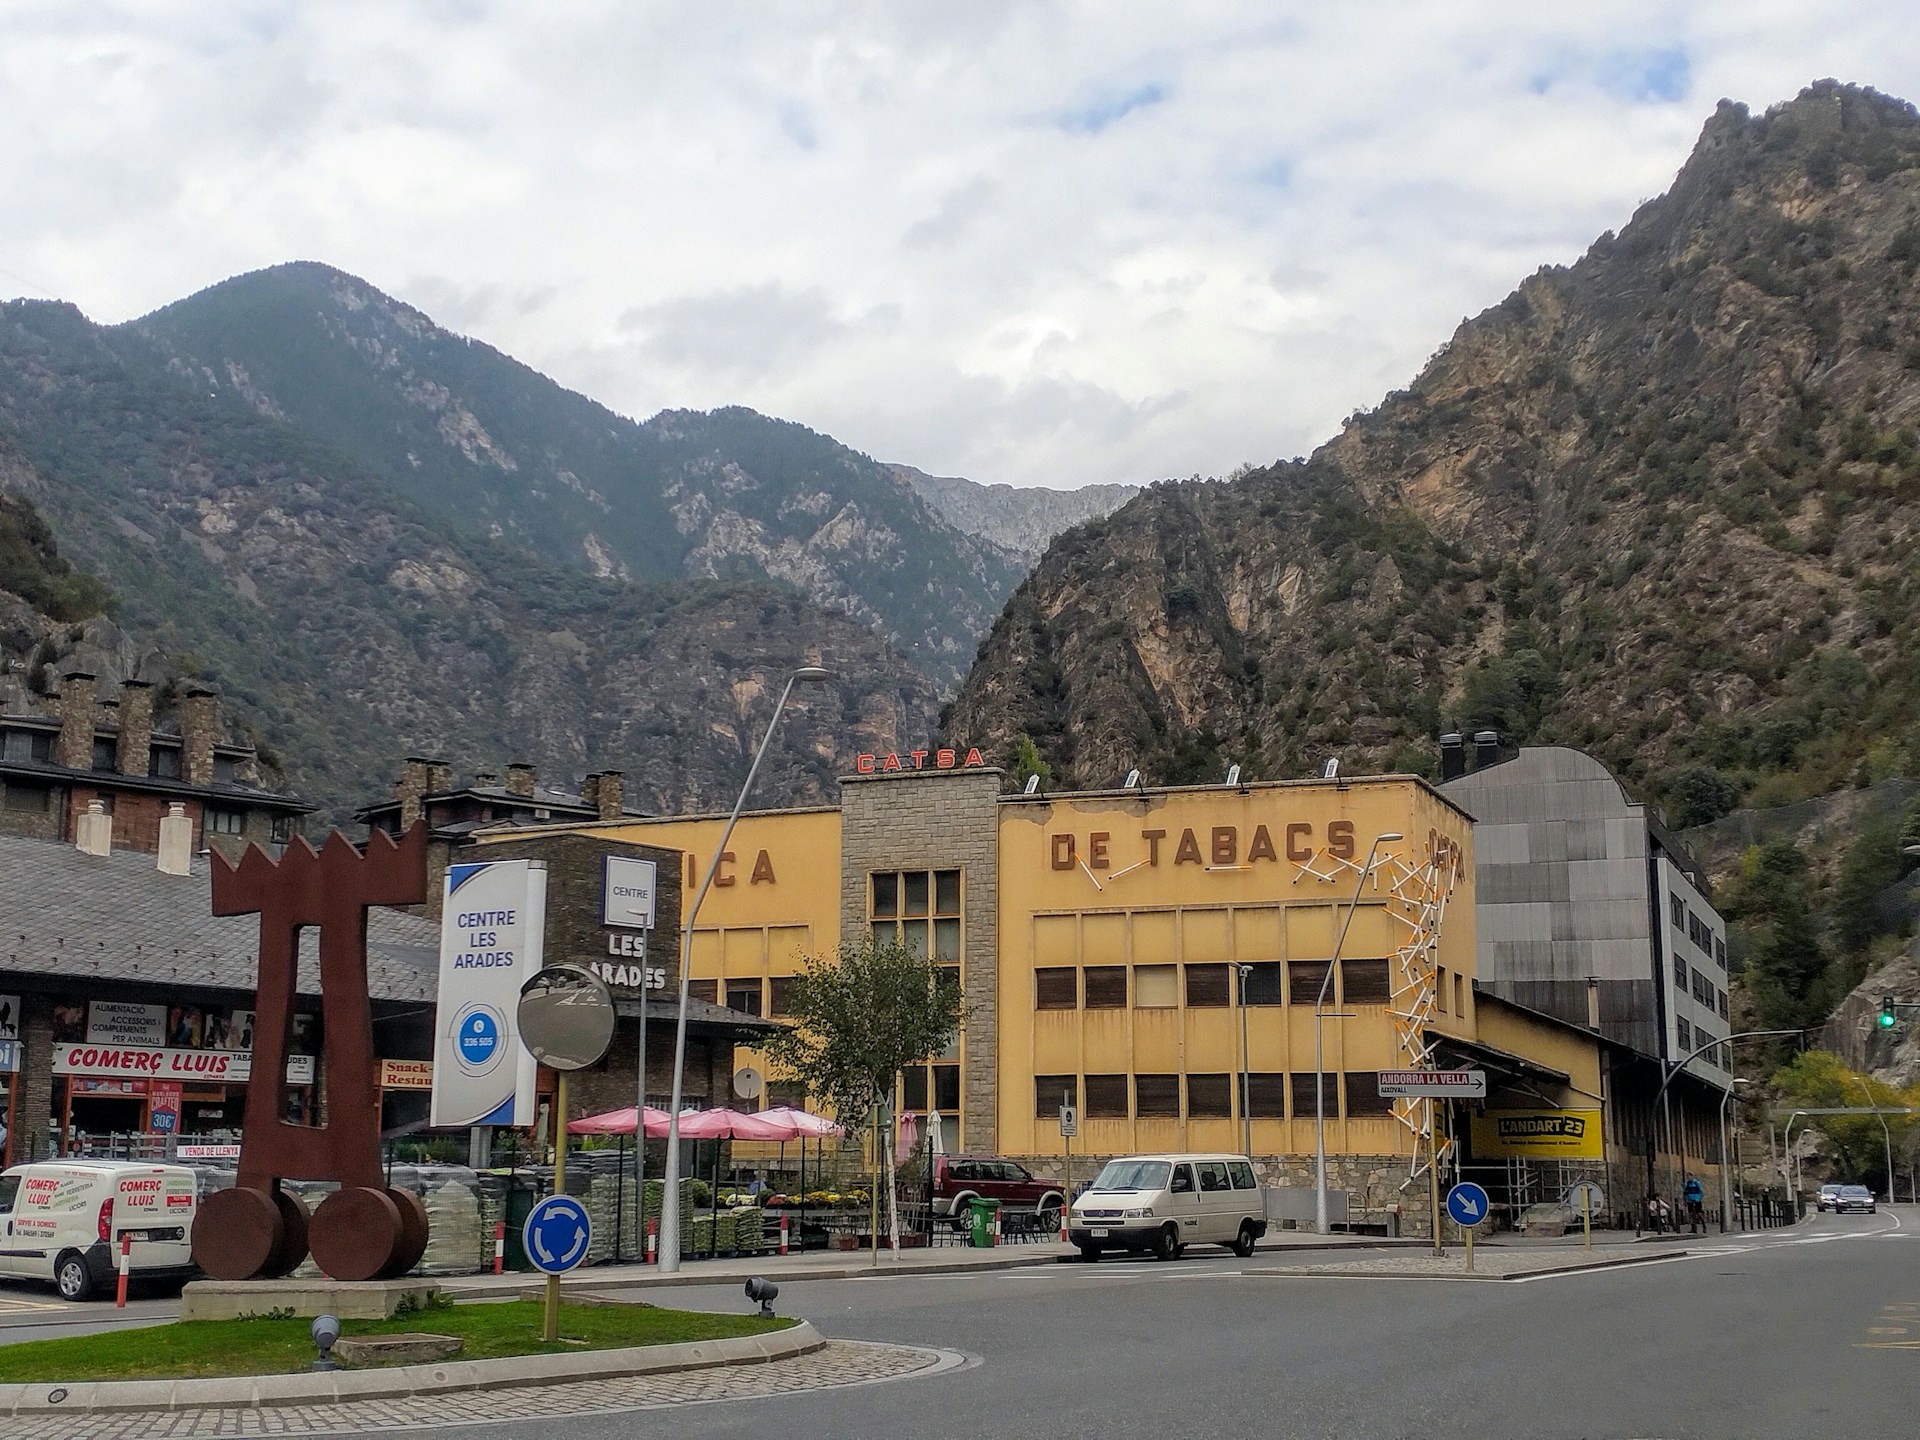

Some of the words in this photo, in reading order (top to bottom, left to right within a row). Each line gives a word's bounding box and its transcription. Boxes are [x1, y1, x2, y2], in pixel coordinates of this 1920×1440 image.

[857, 747, 985, 773] CATSA
[1051, 831, 1110, 871] DE
[1141, 820, 1355, 867] TABACS
[613, 886, 649, 899] CENTRE
[457, 910, 516, 928] CENTRE
[470, 931, 497, 948] LES
[608, 933, 645, 958] LES
[453, 951, 514, 969] ARADES
[92, 1023, 147, 1034] COMPLEMENTS
[111, 1016, 157, 1026] ACCESSORIS
[112, 1035, 126, 1043] PER
[127, 1035, 160, 1045] ANIMALS
[68, 1048, 163, 1075] COMERÇ
[172, 1053, 230, 1073] LLUIS
[1381, 1074, 1425, 1084] ANDORRA
[1426, 1074, 1439, 1084] LA
[1439, 1074, 1468, 1084] VELLA
[151, 1096, 180, 1112] CRAFTED
[1501, 1120, 1562, 1134] L'ANDART
[1564, 1120, 1583, 1135] 23
[184, 1147, 205, 1156] VENDA
[206, 1147, 215, 1156] DE
[216, 1147, 238, 1156] LLENYA
[27, 1193, 52, 1206] LLUIS
[127, 1195, 156, 1207] LLUIS
